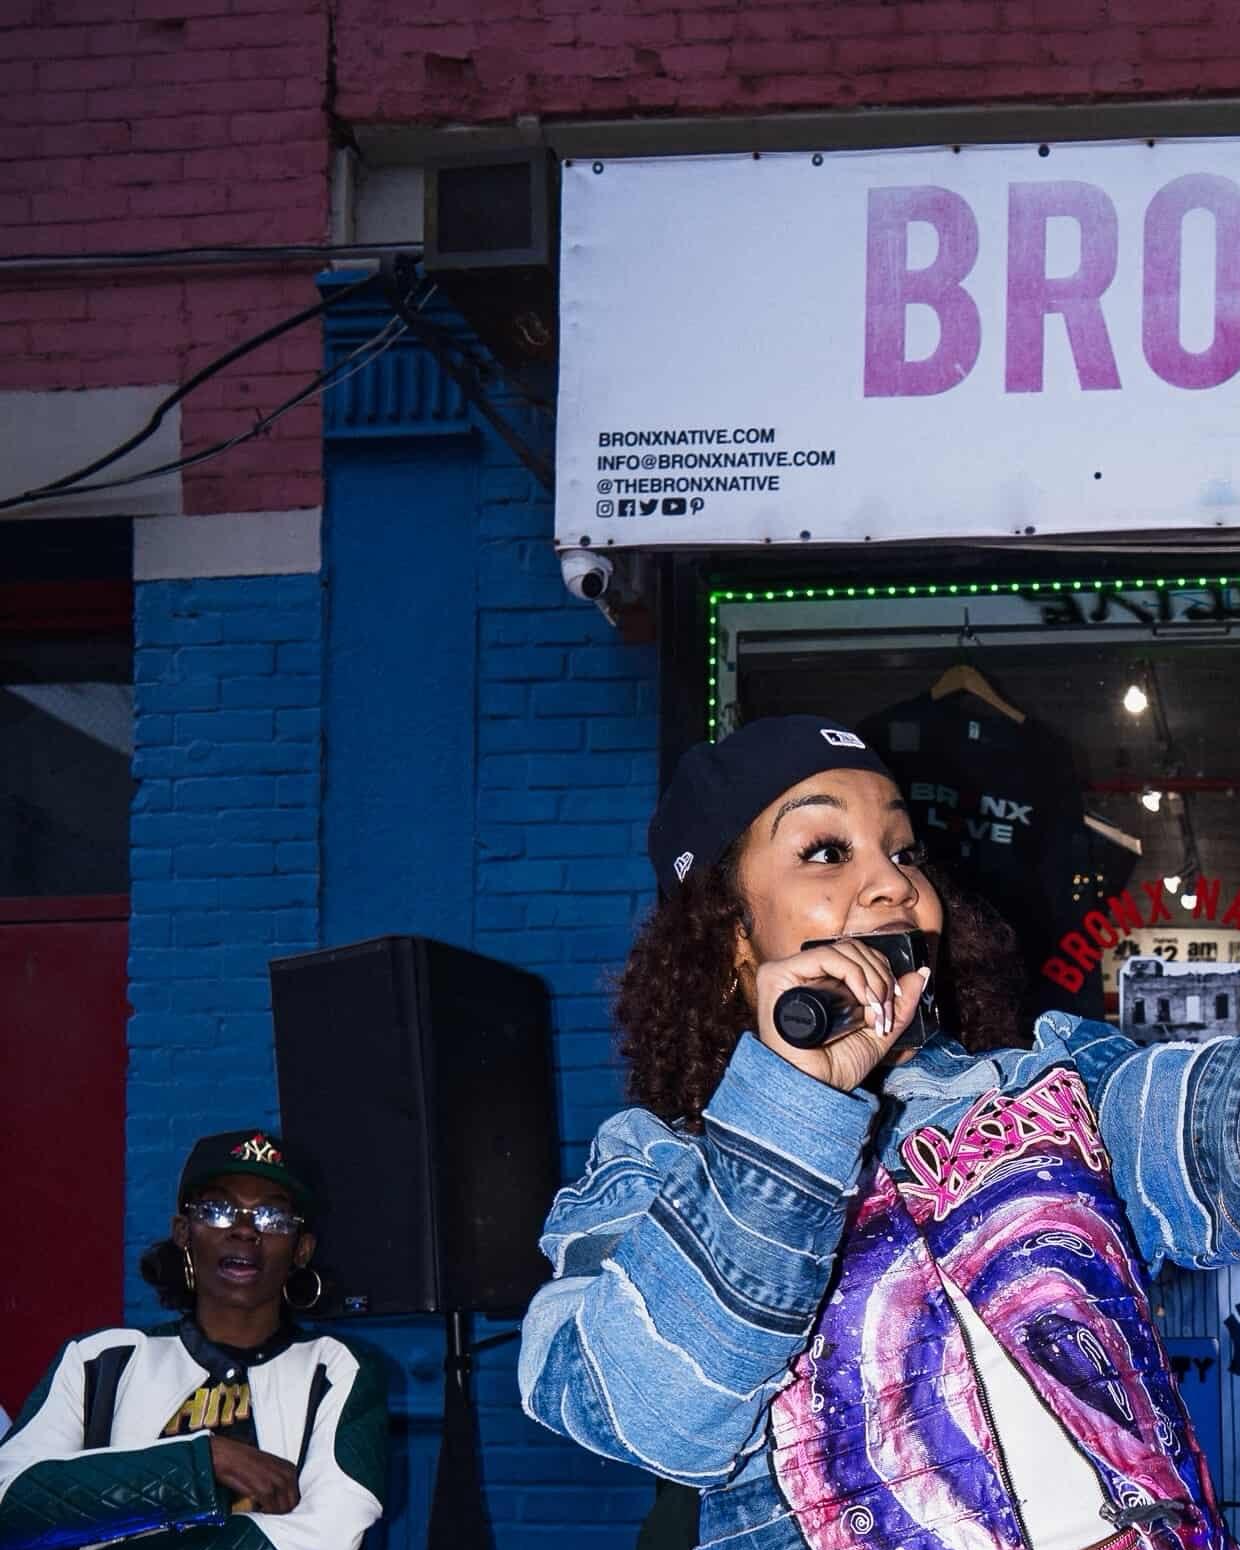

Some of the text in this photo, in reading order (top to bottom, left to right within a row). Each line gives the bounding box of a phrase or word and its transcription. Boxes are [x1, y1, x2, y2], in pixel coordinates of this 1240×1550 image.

[598, 428, 775, 447] BRONXNATIVE.COM
[597, 449, 835, 470] INFO@BRONXNATIVE.COM
[597, 474, 779, 494] @THEBRONXNATIVE
[1041, 874, 1172, 993] BRONX
